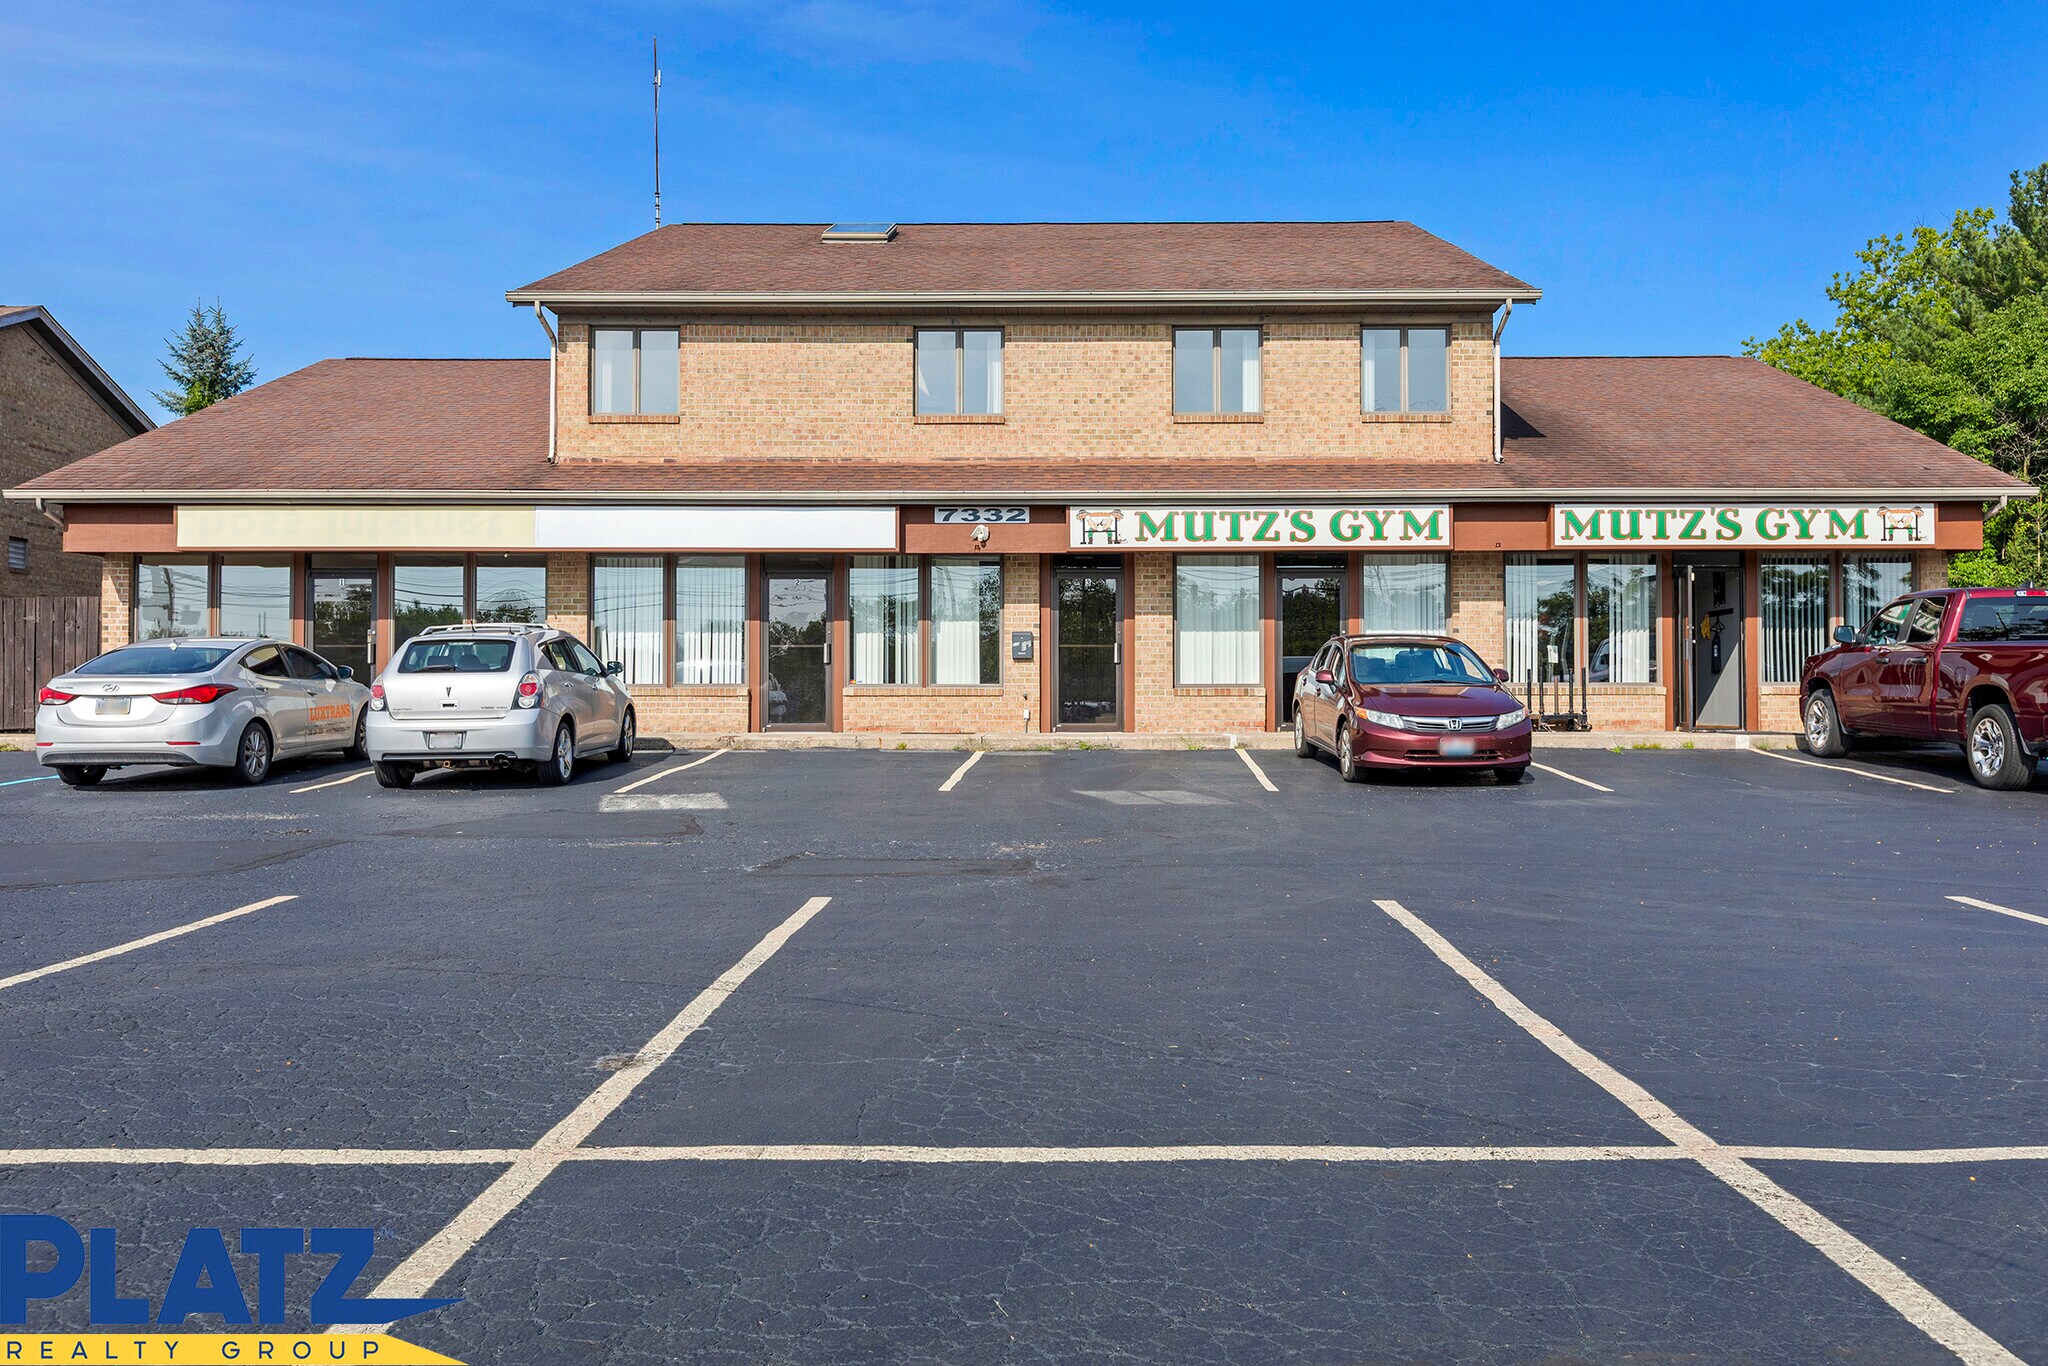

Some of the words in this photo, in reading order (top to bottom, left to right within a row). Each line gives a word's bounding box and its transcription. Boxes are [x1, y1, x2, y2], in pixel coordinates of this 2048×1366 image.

[938, 508, 1026, 522] 7332
[1134, 509, 1314, 543] MUTZ'S
[1329, 509, 1444, 542] GYM
[1559, 508, 1743, 541] MUTZ'S
[1755, 508, 1869, 541] GYM
[309, 703, 351, 721] LUXTRANS
